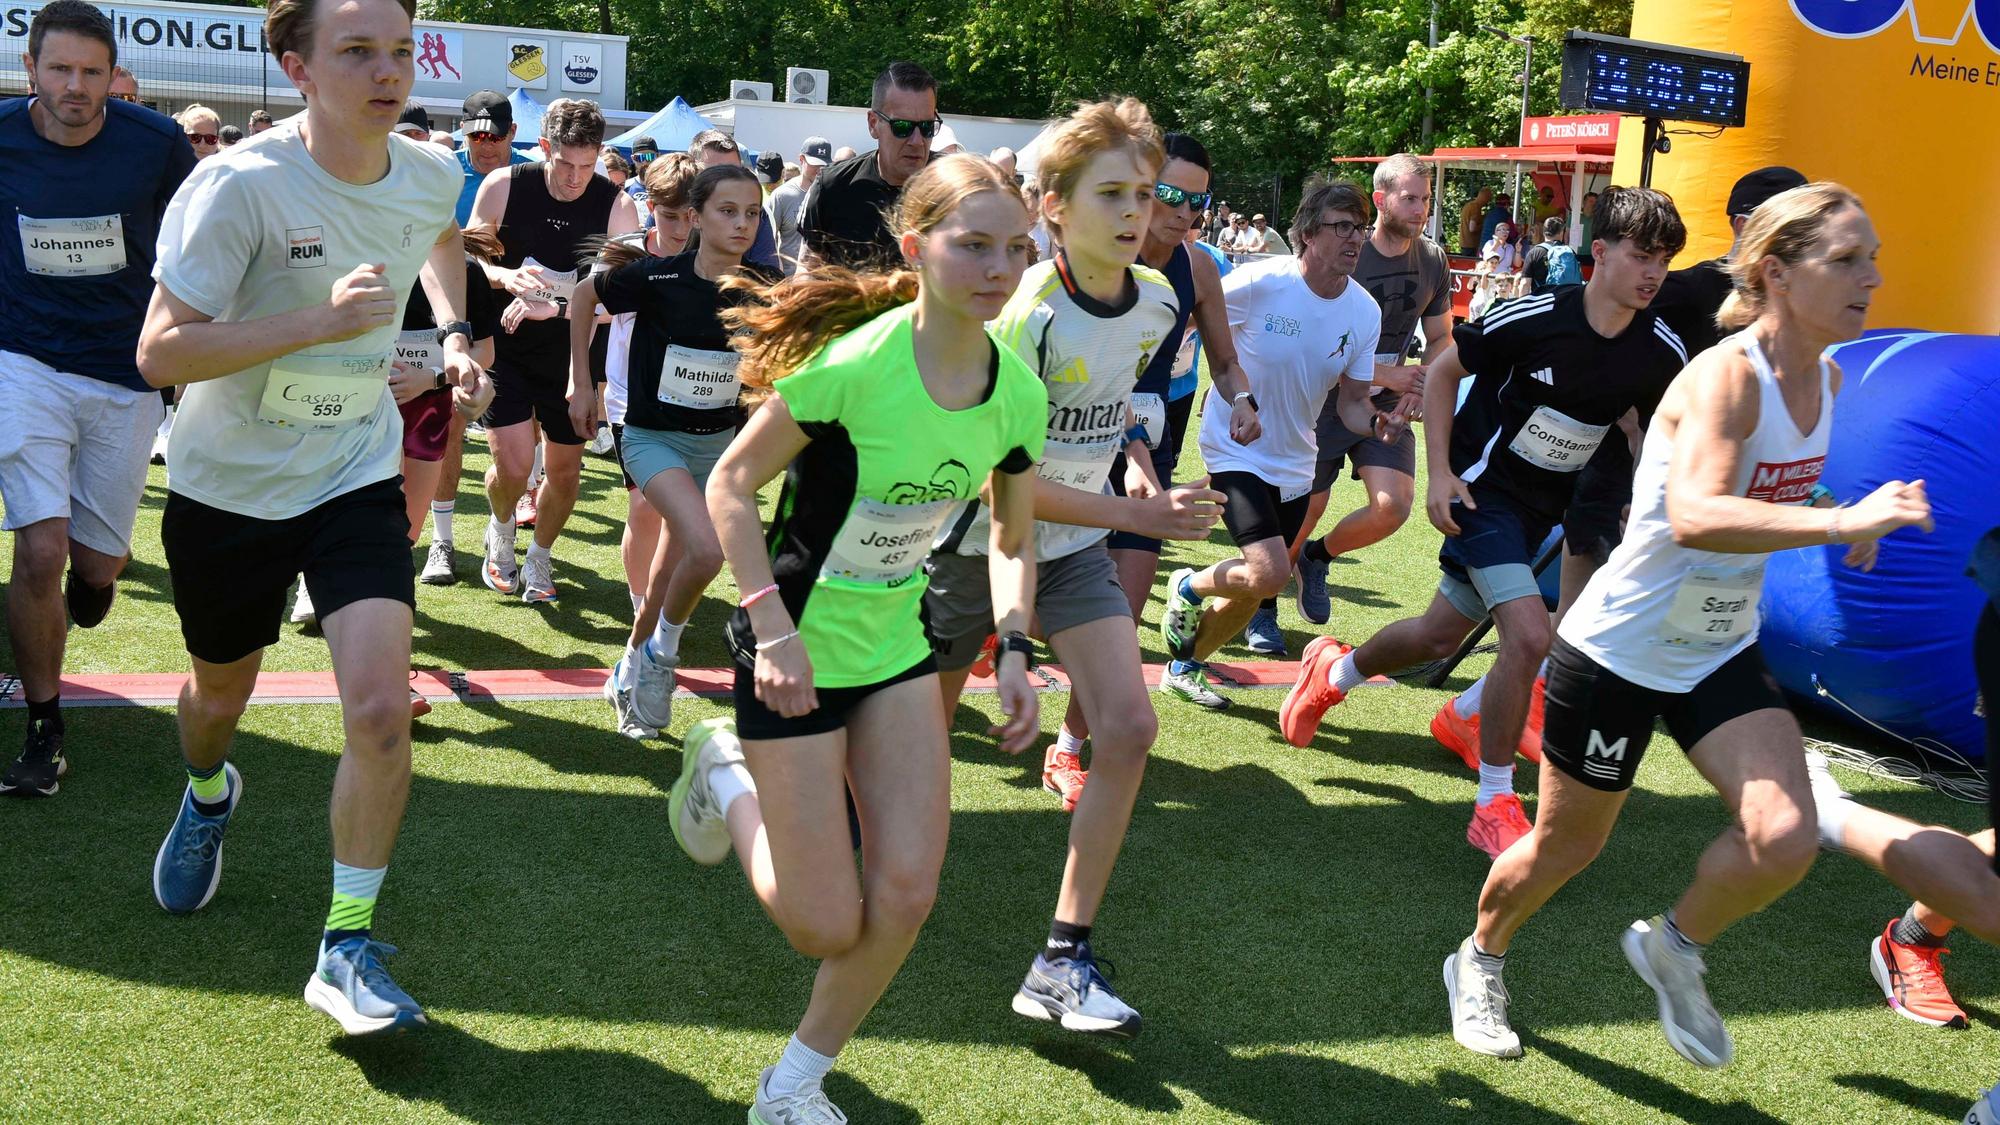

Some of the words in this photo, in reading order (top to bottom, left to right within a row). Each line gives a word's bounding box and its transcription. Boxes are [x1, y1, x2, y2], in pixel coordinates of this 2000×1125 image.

[509, 49, 542, 69] GLESSEN
[573, 55, 591, 64] TSV
[1910, 53, 1980, 83] Meine
[567, 71, 596, 79] GLESSEN
[1546, 122, 1577, 138] PETERS
[30, 238, 115, 250] Johannes
[67, 253, 83, 263] 13
[290, 244, 323, 260] RUN
[648, 273, 679, 281] STANNO
[535, 289, 552, 300] 519
[396, 347, 428, 358] Vera
[674, 366, 734, 383] Mathilda
[282, 383, 359, 405] Caspar
[692, 386, 713, 396] 289
[312, 404, 343, 416] 559
[1546, 449, 1570, 461] 238
[880, 551, 909, 566] 457
[1701, 596, 1748, 613] Sarah
[1705, 619, 1735, 632] 270
